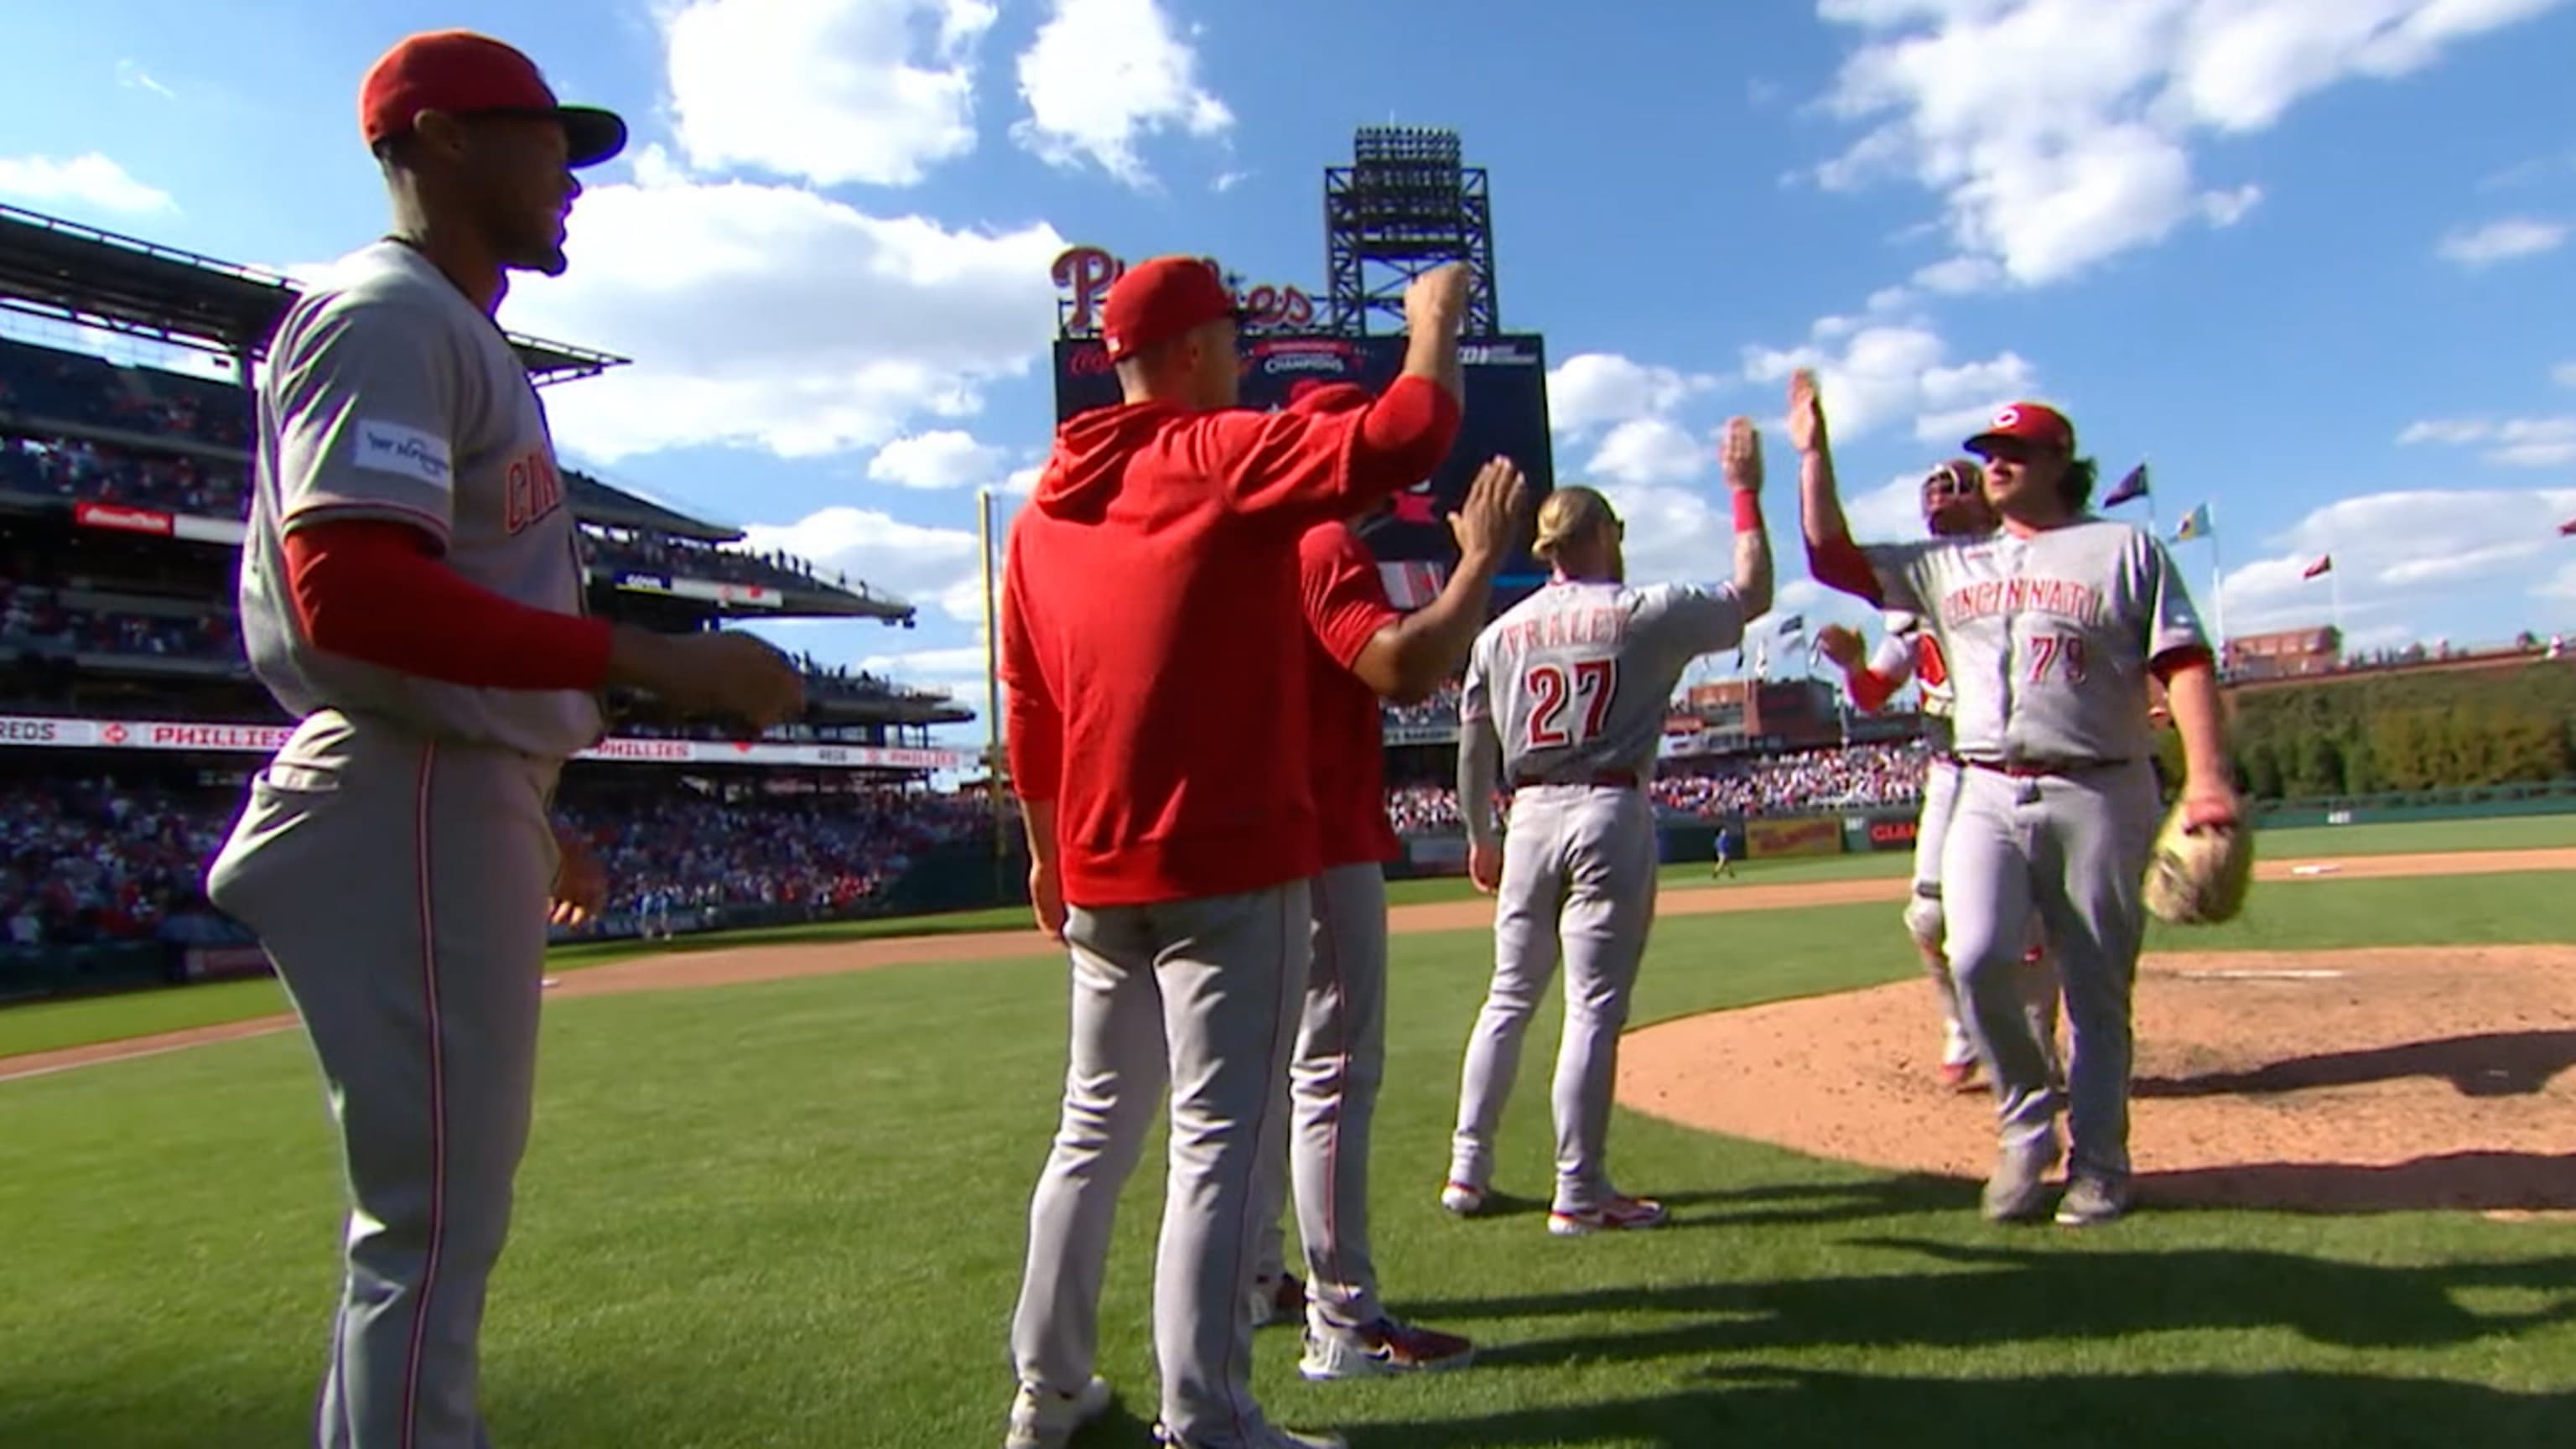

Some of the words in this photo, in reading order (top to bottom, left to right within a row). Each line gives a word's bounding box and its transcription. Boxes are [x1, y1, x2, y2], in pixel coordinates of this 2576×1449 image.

[1264, 356, 1344, 375] CHAMPIONS
[1502, 606, 1630, 658] FRALEY
[2025, 632, 2086, 688] 79
[1524, 656, 1619, 752] 27
[153, 725, 295, 747] PHILLIES
